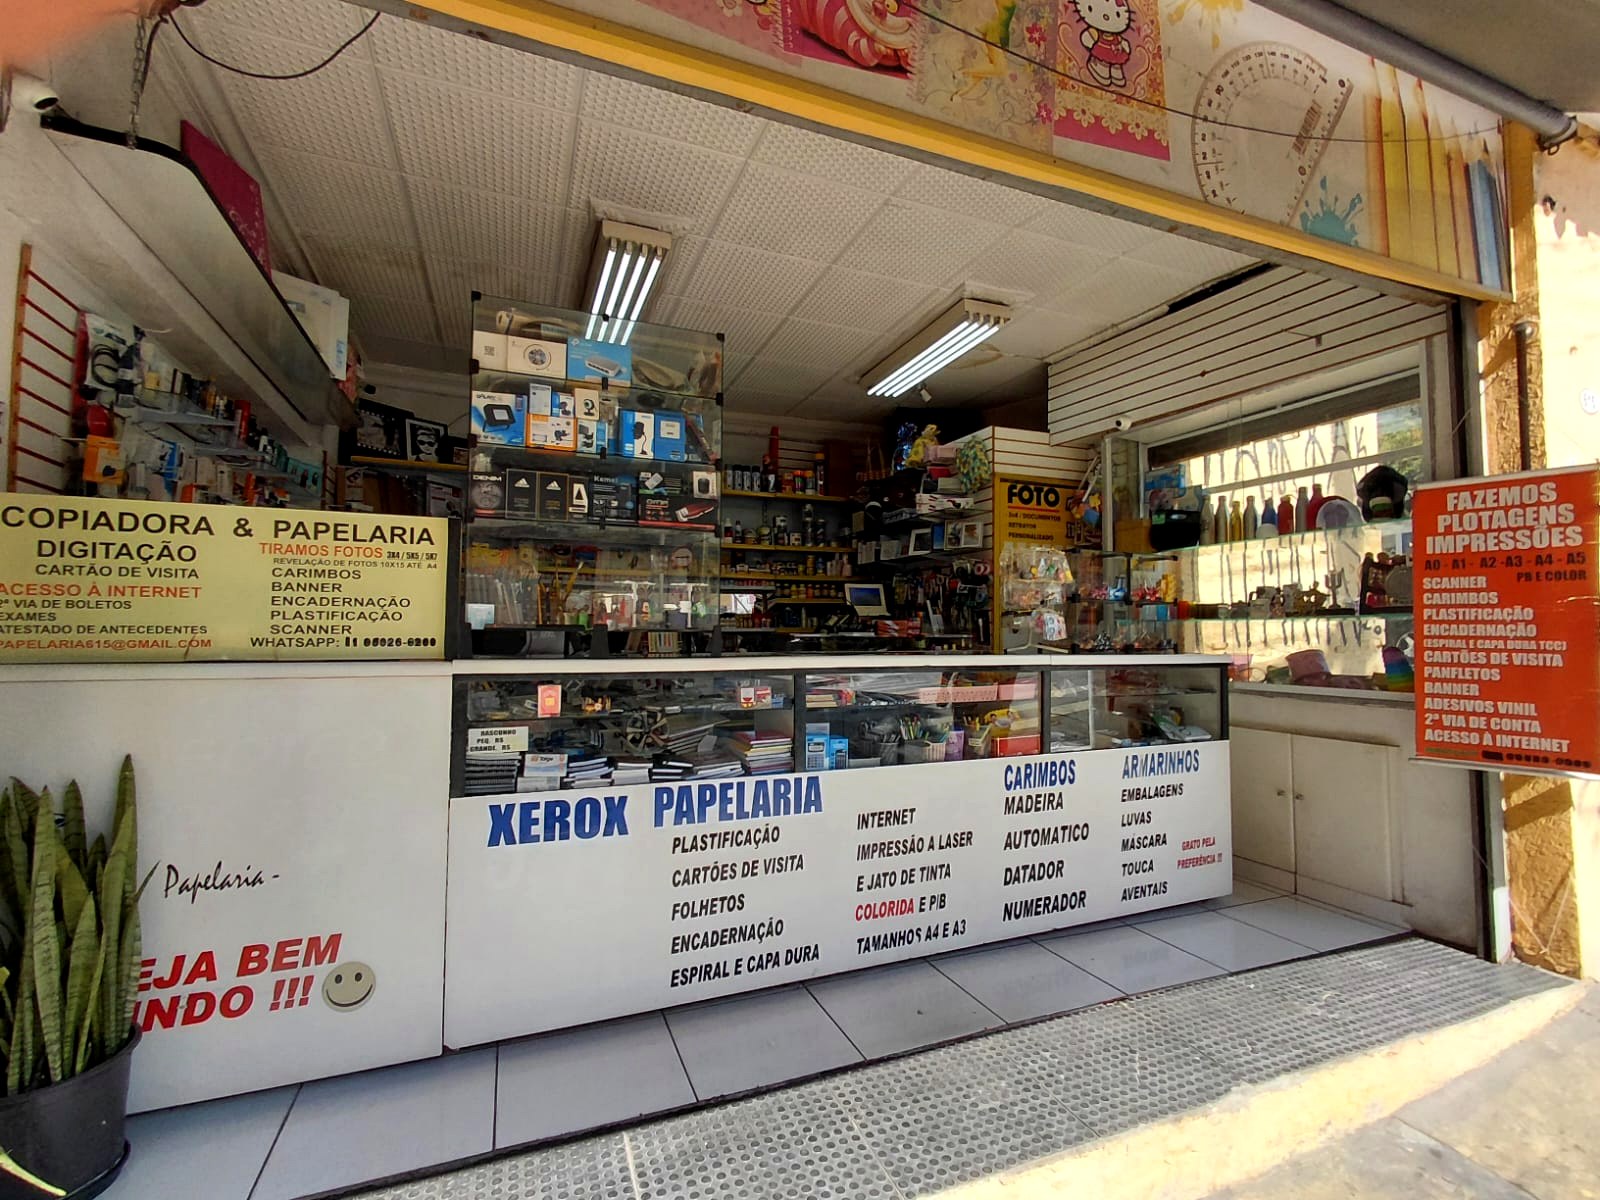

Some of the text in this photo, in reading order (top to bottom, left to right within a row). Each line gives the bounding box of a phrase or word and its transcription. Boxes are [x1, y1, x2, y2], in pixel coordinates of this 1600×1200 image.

[1008, 484, 1060, 508] FOTO
[1447, 482, 1557, 512] FAZEMOS
[1, 506, 436, 546] COPIADORA & PAPELARIA
[1438, 504, 1574, 533] PLOTAGENS
[1426, 524, 1583, 554] IMPRESSÕES
[38, 540, 198, 564] DIGITAÇÃO
[259, 542, 329, 557] TIRAMOS
[334, 546, 383, 558] FOTOS
[36, 563, 199, 579] CARTÃO DE VISITA
[273, 558, 331, 566] REVELAÇÃO
[1425, 560, 1440, 571] A0
[1452, 558, 1466, 569] A1
[1480, 556, 1496, 568] A2
[1536, 554, 1553, 566] A4
[1566, 552, 1586, 566] A5
[272, 568, 362, 580] CARIMBOS
[1423, 576, 1487, 590] SCANNER
[1517, 570, 1586, 582] PB E COLOR
[0, 583, 80, 597] ACESSO
[108, 586, 202, 599] INTERNET
[272, 582, 342, 593] BANNER
[1423, 592, 1498, 604] CARIMBOS
[14, 600, 38, 608] VIA
[42, 600, 61, 608] DE
[66, 601, 132, 610] BOLETOS
[272, 596, 410, 608] ENCADERNAÇÃO
[270, 610, 403, 622] PLASTIFICAÇÃO
[1424, 606, 1534, 622] PLASTIFICAÇÃO
[76, 626, 96, 634] DE
[100, 626, 208, 634] ANTECEDENTES
[270, 624, 352, 634] SCANNER
[1424, 622, 1536, 638] ENCADERNAÇÃO
[250, 638, 340, 648] WHATSAPP:
[1470, 640, 1474, 648] E
[1476, 640, 1504, 649] CAPA
[1507, 640, 1536, 650] DURA
[1539, 641, 1567, 651] TCC)
[1424, 650, 1564, 667] CARTÕES DE VISITA
[1424, 666, 1500, 681] PANFLETOS
[1424, 682, 1480, 696] BANNER
[1424, 698, 1538, 716] ADESIVOS VINIL
[1442, 715, 1466, 728] VIA
[1469, 716, 1487, 729] DE
[1490, 718, 1541, 733] CONTA
[1424, 728, 1480, 744] ACESSO
[1496, 736, 1570, 752] INTERNET
[1122, 748, 1200, 780] ARMARINHOS
[1004, 759, 1076, 792] CARIMBOS
[654, 776, 823, 828] PAPELARIA
[1120, 783, 1184, 802] EMBALAGENS
[1004, 792, 1064, 815] MADEIRA
[487, 796, 629, 848] XEROX
[857, 808, 916, 830] INTERNET
[1121, 811, 1152, 828] LUVAS
[672, 824, 780, 854] PLASTIFICAÇÃO
[856, 830, 973, 861] IMPRESSÃO A LASER
[1004, 823, 1090, 850] AUTOMATICO
[672, 854, 804, 888] CARTÕES DE VISITA
[856, 864, 951, 892] E JATO DE TINTA
[1004, 860, 1064, 886] DATADOR
[1122, 859, 1154, 877] TOUCA
[164, 860, 264, 904] Papelaria
[1121, 881, 1168, 902] AVENTAIS
[672, 894, 745, 921] FOLHETOS
[855, 898, 914, 922] COLORIDA
[919, 896, 926, 912] E
[1002, 890, 1087, 922] NUMERADOR
[671, 918, 784, 954] ENCADERNAÇÃO
[856, 919, 966, 954] TAMANHOS A4 E A3
[236, 933, 342, 977] BEM
[670, 944, 820, 988] ESPIRAL E CAPA DURA
[269, 975, 314, 1012] !!!
